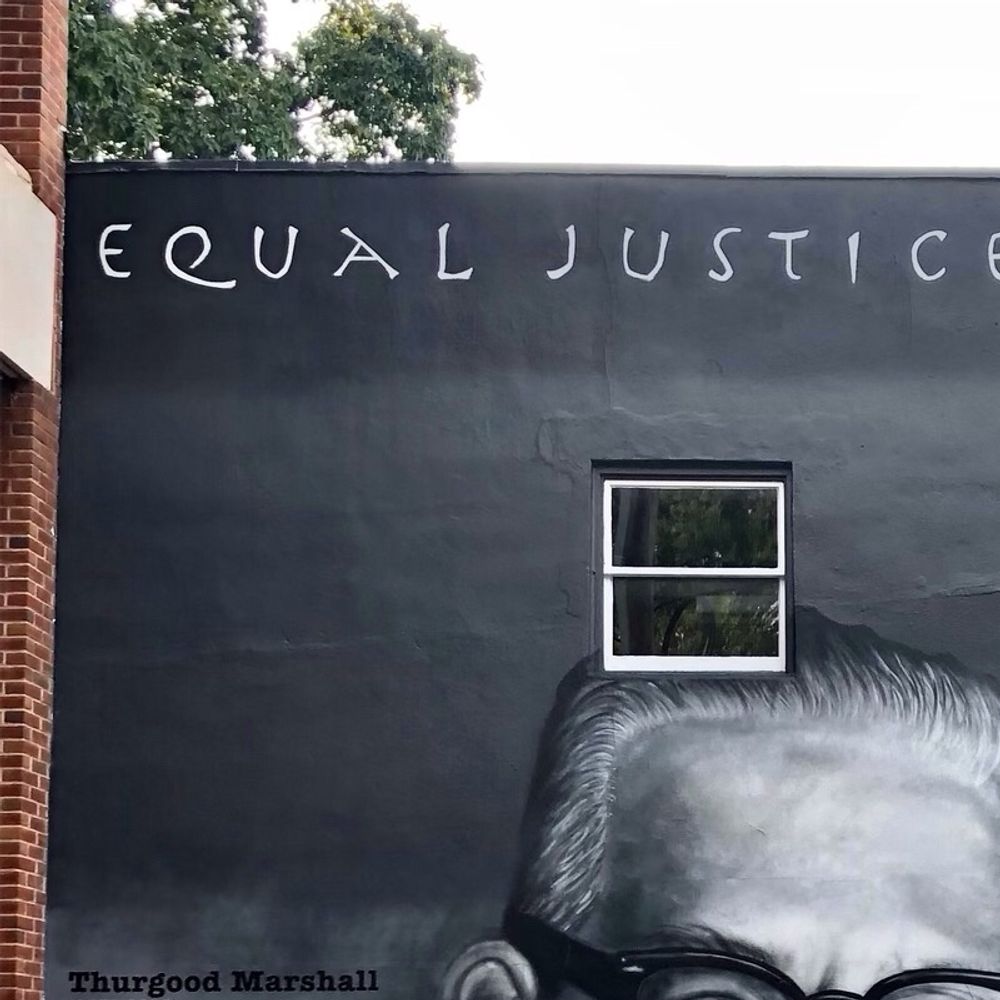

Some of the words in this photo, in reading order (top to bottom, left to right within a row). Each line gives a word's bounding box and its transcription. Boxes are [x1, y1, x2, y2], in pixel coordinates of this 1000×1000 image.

[98, 223, 472, 288] EQUAL
[68, 971, 221, 998] Thurgood
[231, 970, 379, 992] Marshall
